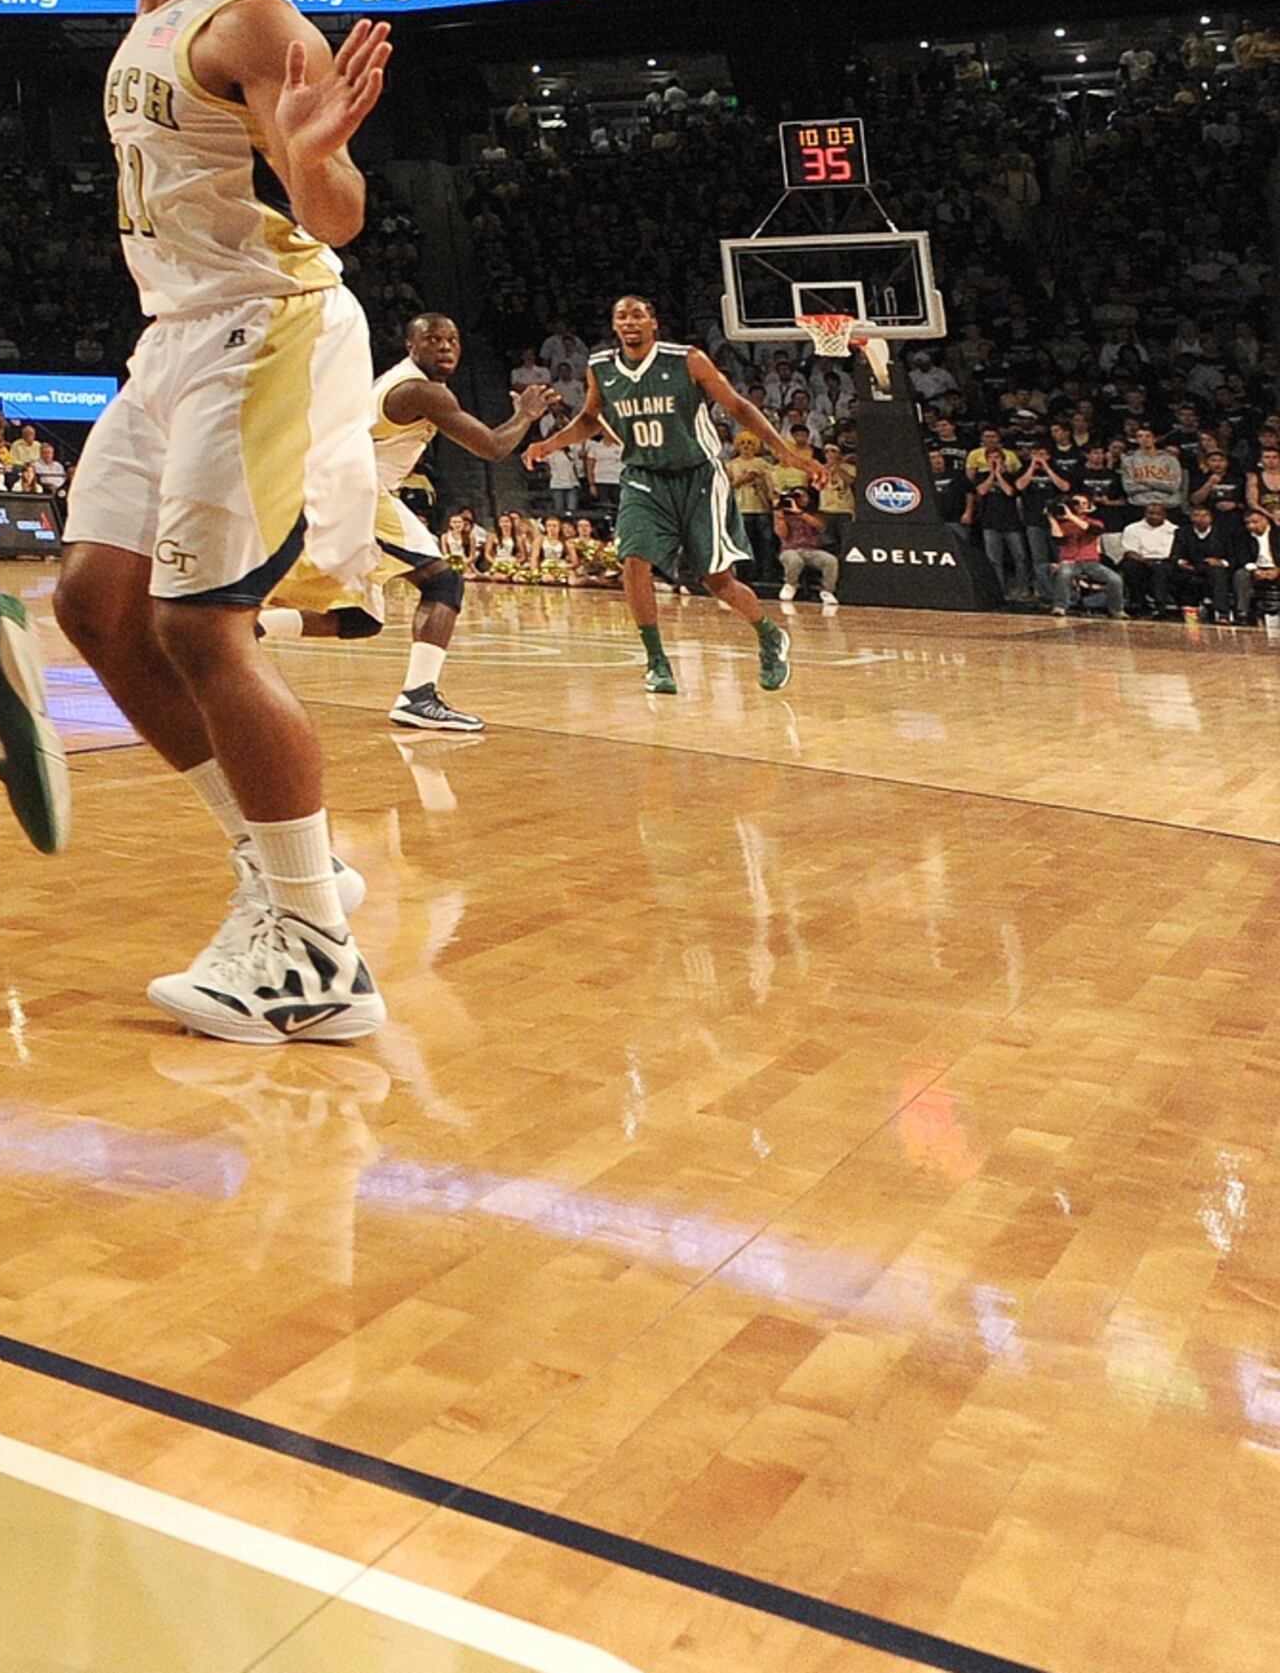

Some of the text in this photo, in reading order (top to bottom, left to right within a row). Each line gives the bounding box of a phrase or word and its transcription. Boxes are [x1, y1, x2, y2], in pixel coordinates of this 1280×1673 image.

[107, 67, 179, 131] ECH
[799, 127, 855, 146] 10 03
[802, 147, 852, 181] 35
[49, 390, 107, 405] TECHRON
[613, 396, 675, 418] TULANE
[633, 421, 663, 447] 00
[156, 539, 197, 573] GT
[872, 548, 956, 567] DELTA
